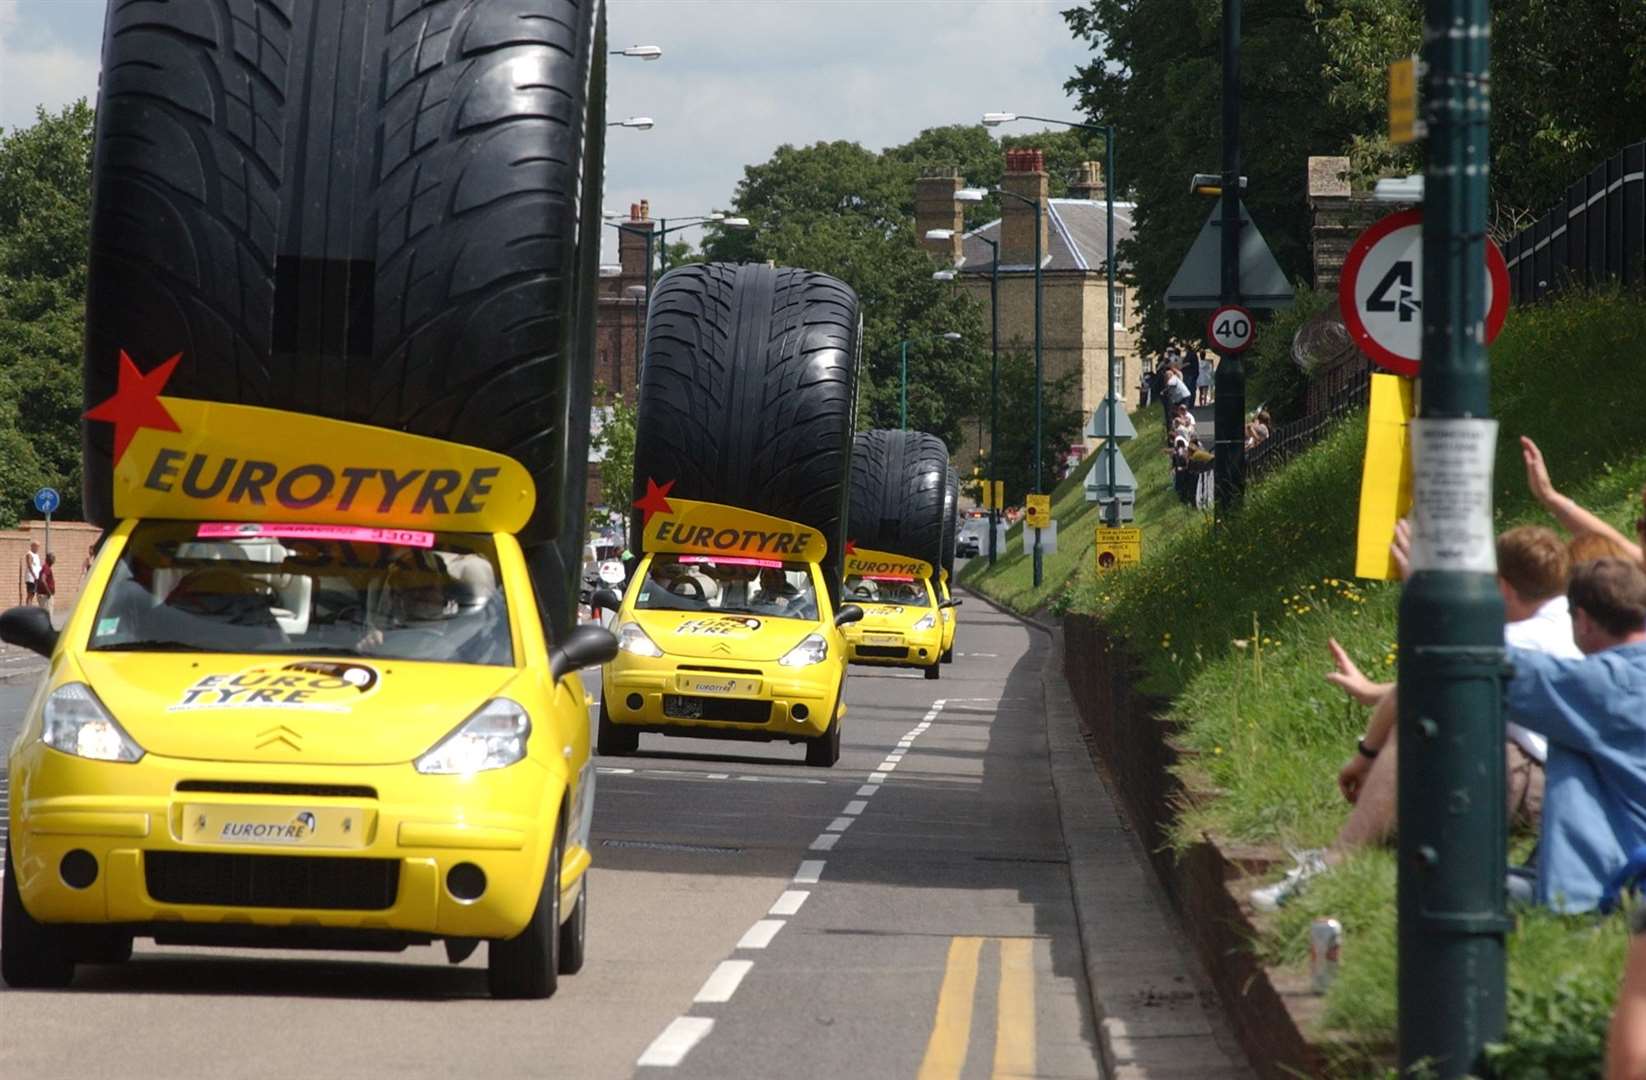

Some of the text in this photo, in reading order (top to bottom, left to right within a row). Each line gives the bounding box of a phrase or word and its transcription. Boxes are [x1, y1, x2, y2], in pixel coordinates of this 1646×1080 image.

[1366, 260, 1421, 322] 4
[1215, 319, 1249, 338] 40
[143, 447, 500, 515] EUROTYRE
[655, 521, 812, 554] EUROTYRE
[848, 559, 926, 575] EUROTYRE
[676, 626, 732, 634] TYRE
[197, 674, 352, 689] EURO
[183, 688, 317, 704] TYRE
[220, 822, 306, 838] EUROTYRE
